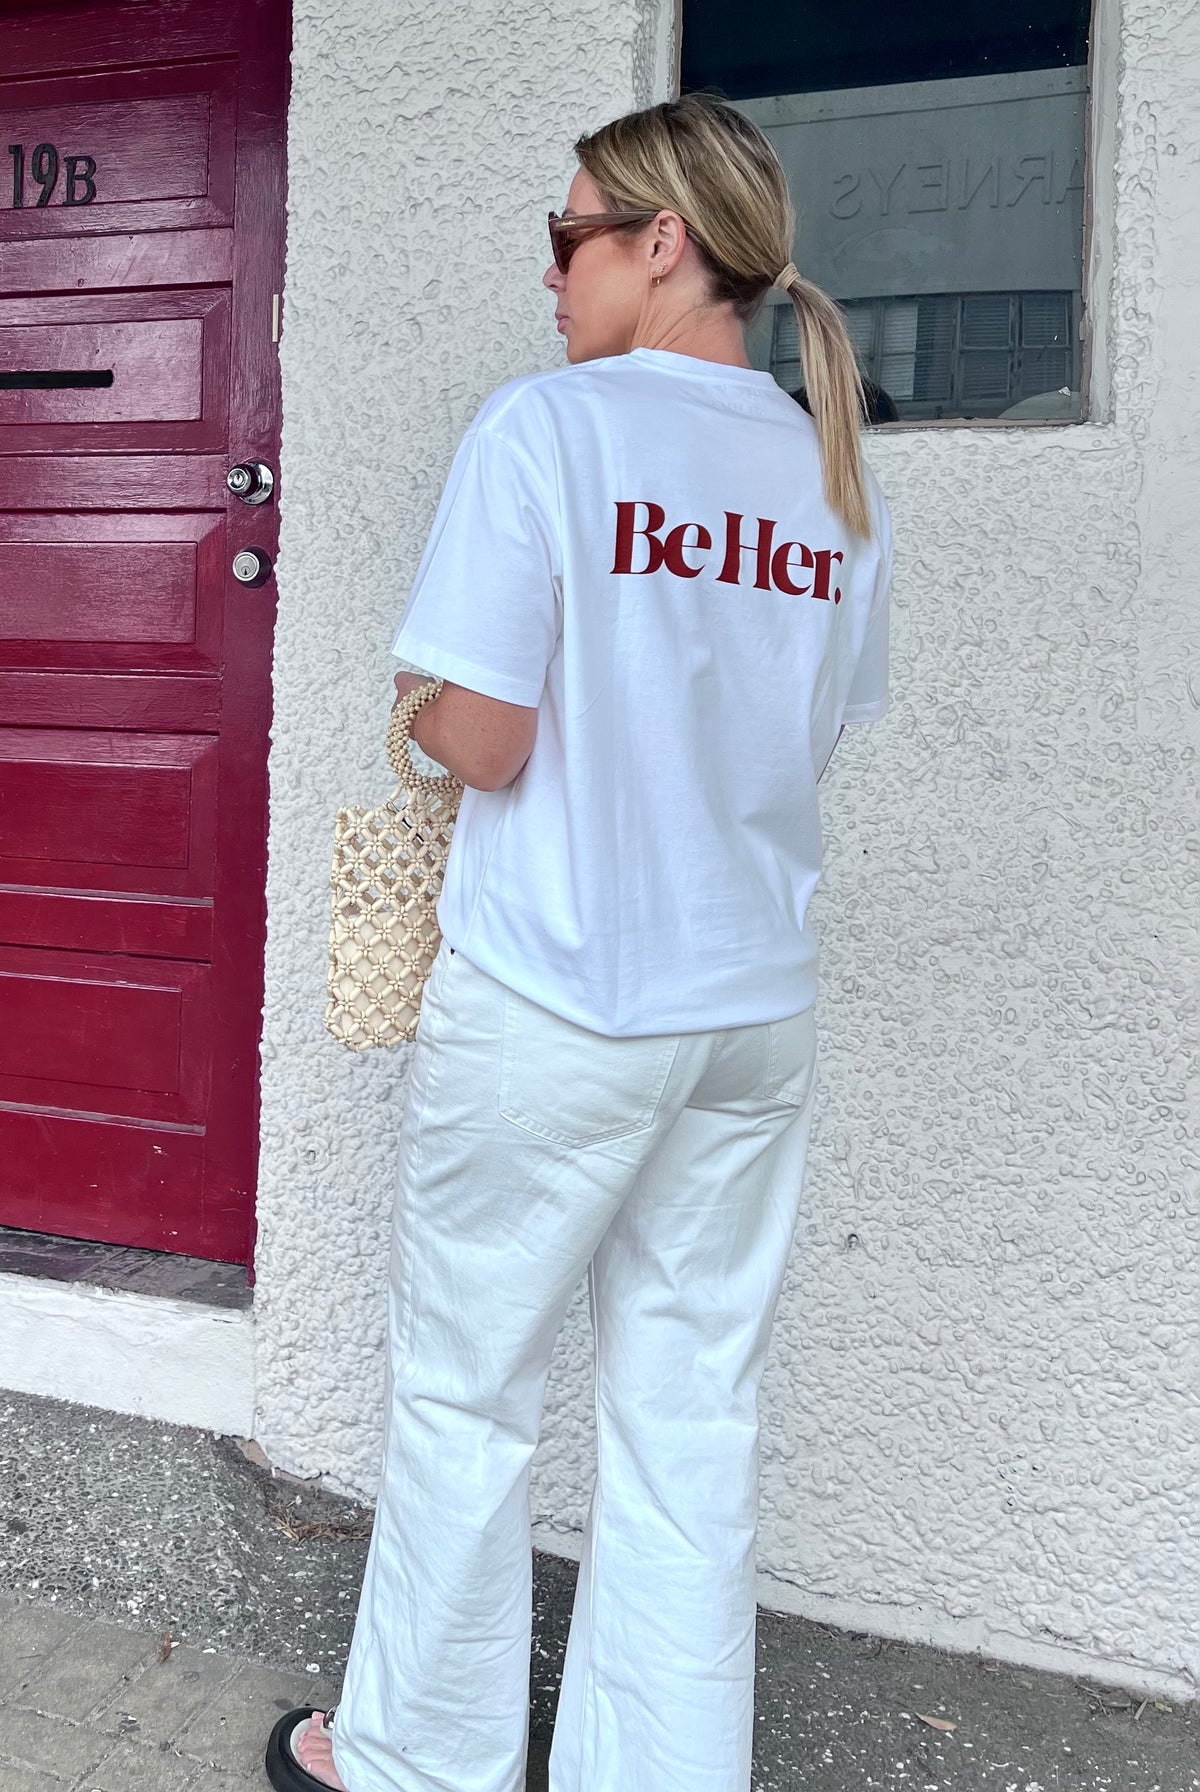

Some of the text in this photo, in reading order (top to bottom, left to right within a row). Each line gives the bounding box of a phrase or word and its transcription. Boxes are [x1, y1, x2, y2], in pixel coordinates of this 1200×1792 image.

[8, 143, 97, 209] 19B
[609, 501, 844, 606] Be Her.
